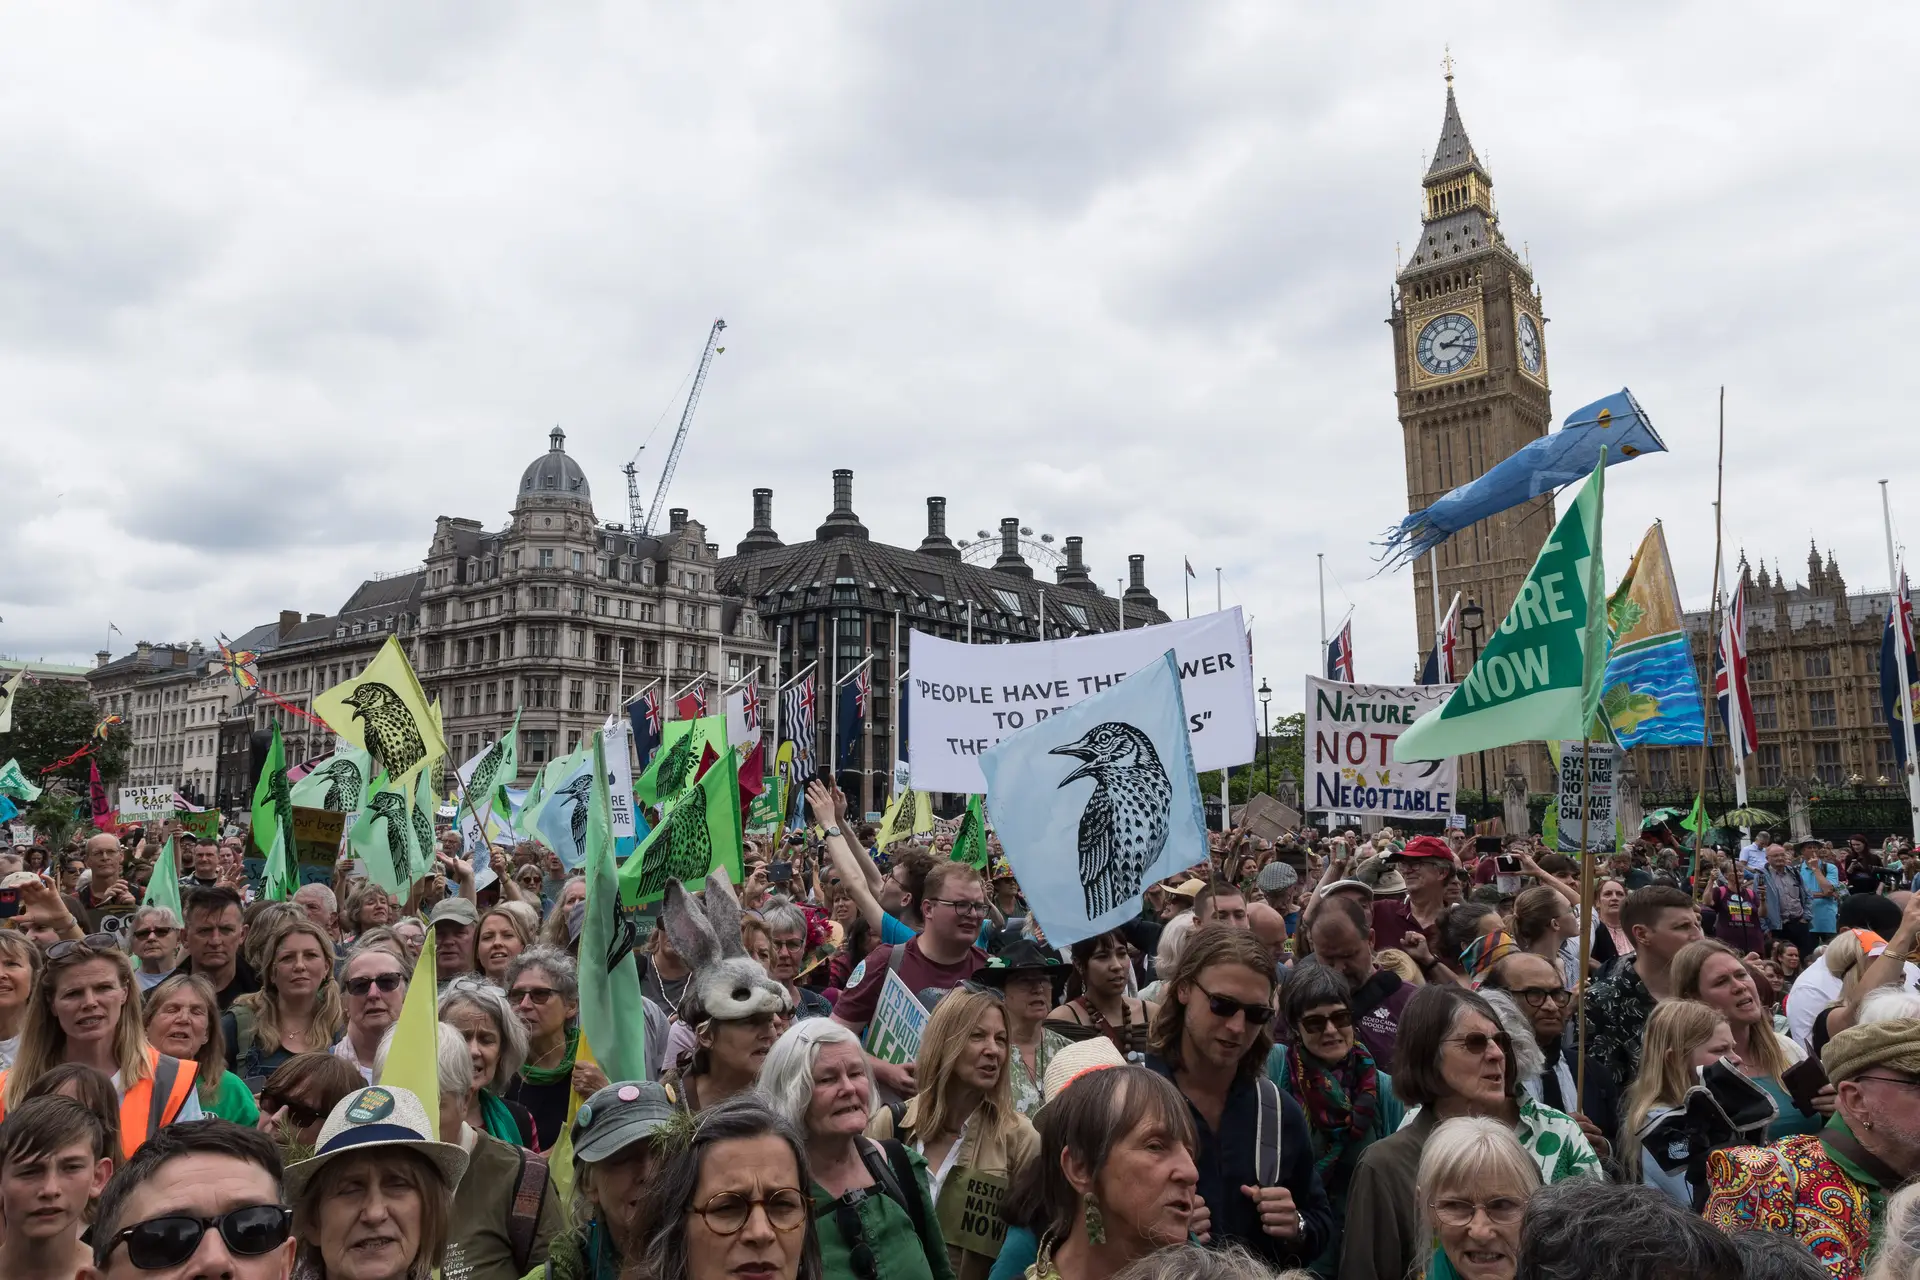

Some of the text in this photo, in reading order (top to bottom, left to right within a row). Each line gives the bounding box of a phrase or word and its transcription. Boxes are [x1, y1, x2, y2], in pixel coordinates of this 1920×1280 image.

[1500, 572, 1573, 635] URE
[916, 652, 1235, 703] "PEOPLE HAVE THE WER
[1464, 645, 1549, 706] NOW
[1317, 689, 1416, 725] NATURE
[993, 711, 1023, 729] TO
[1316, 731, 1399, 766] NOT
[1562, 756, 1611, 770] SYSTEM
[1562, 769, 1612, 782] CHANGE
[124, 787, 159, 797] DON'T
[134, 794, 172, 805] FRACK
[1316, 772, 1450, 812] NEGOTIABLE
[1561, 795, 1611, 807] CLIMATE
[317, 815, 341, 832] bees
[1561, 807, 1610, 820] CHANGE
[885, 977, 924, 1034] IT'S TIME
[878, 998, 920, 1059] LET NATU
[1362, 1021, 1397, 1032] WOODLAND
[867, 1018, 912, 1064] LEA
[967, 1179, 1005, 1200] RESTO
[965, 1196, 999, 1217] NATU
